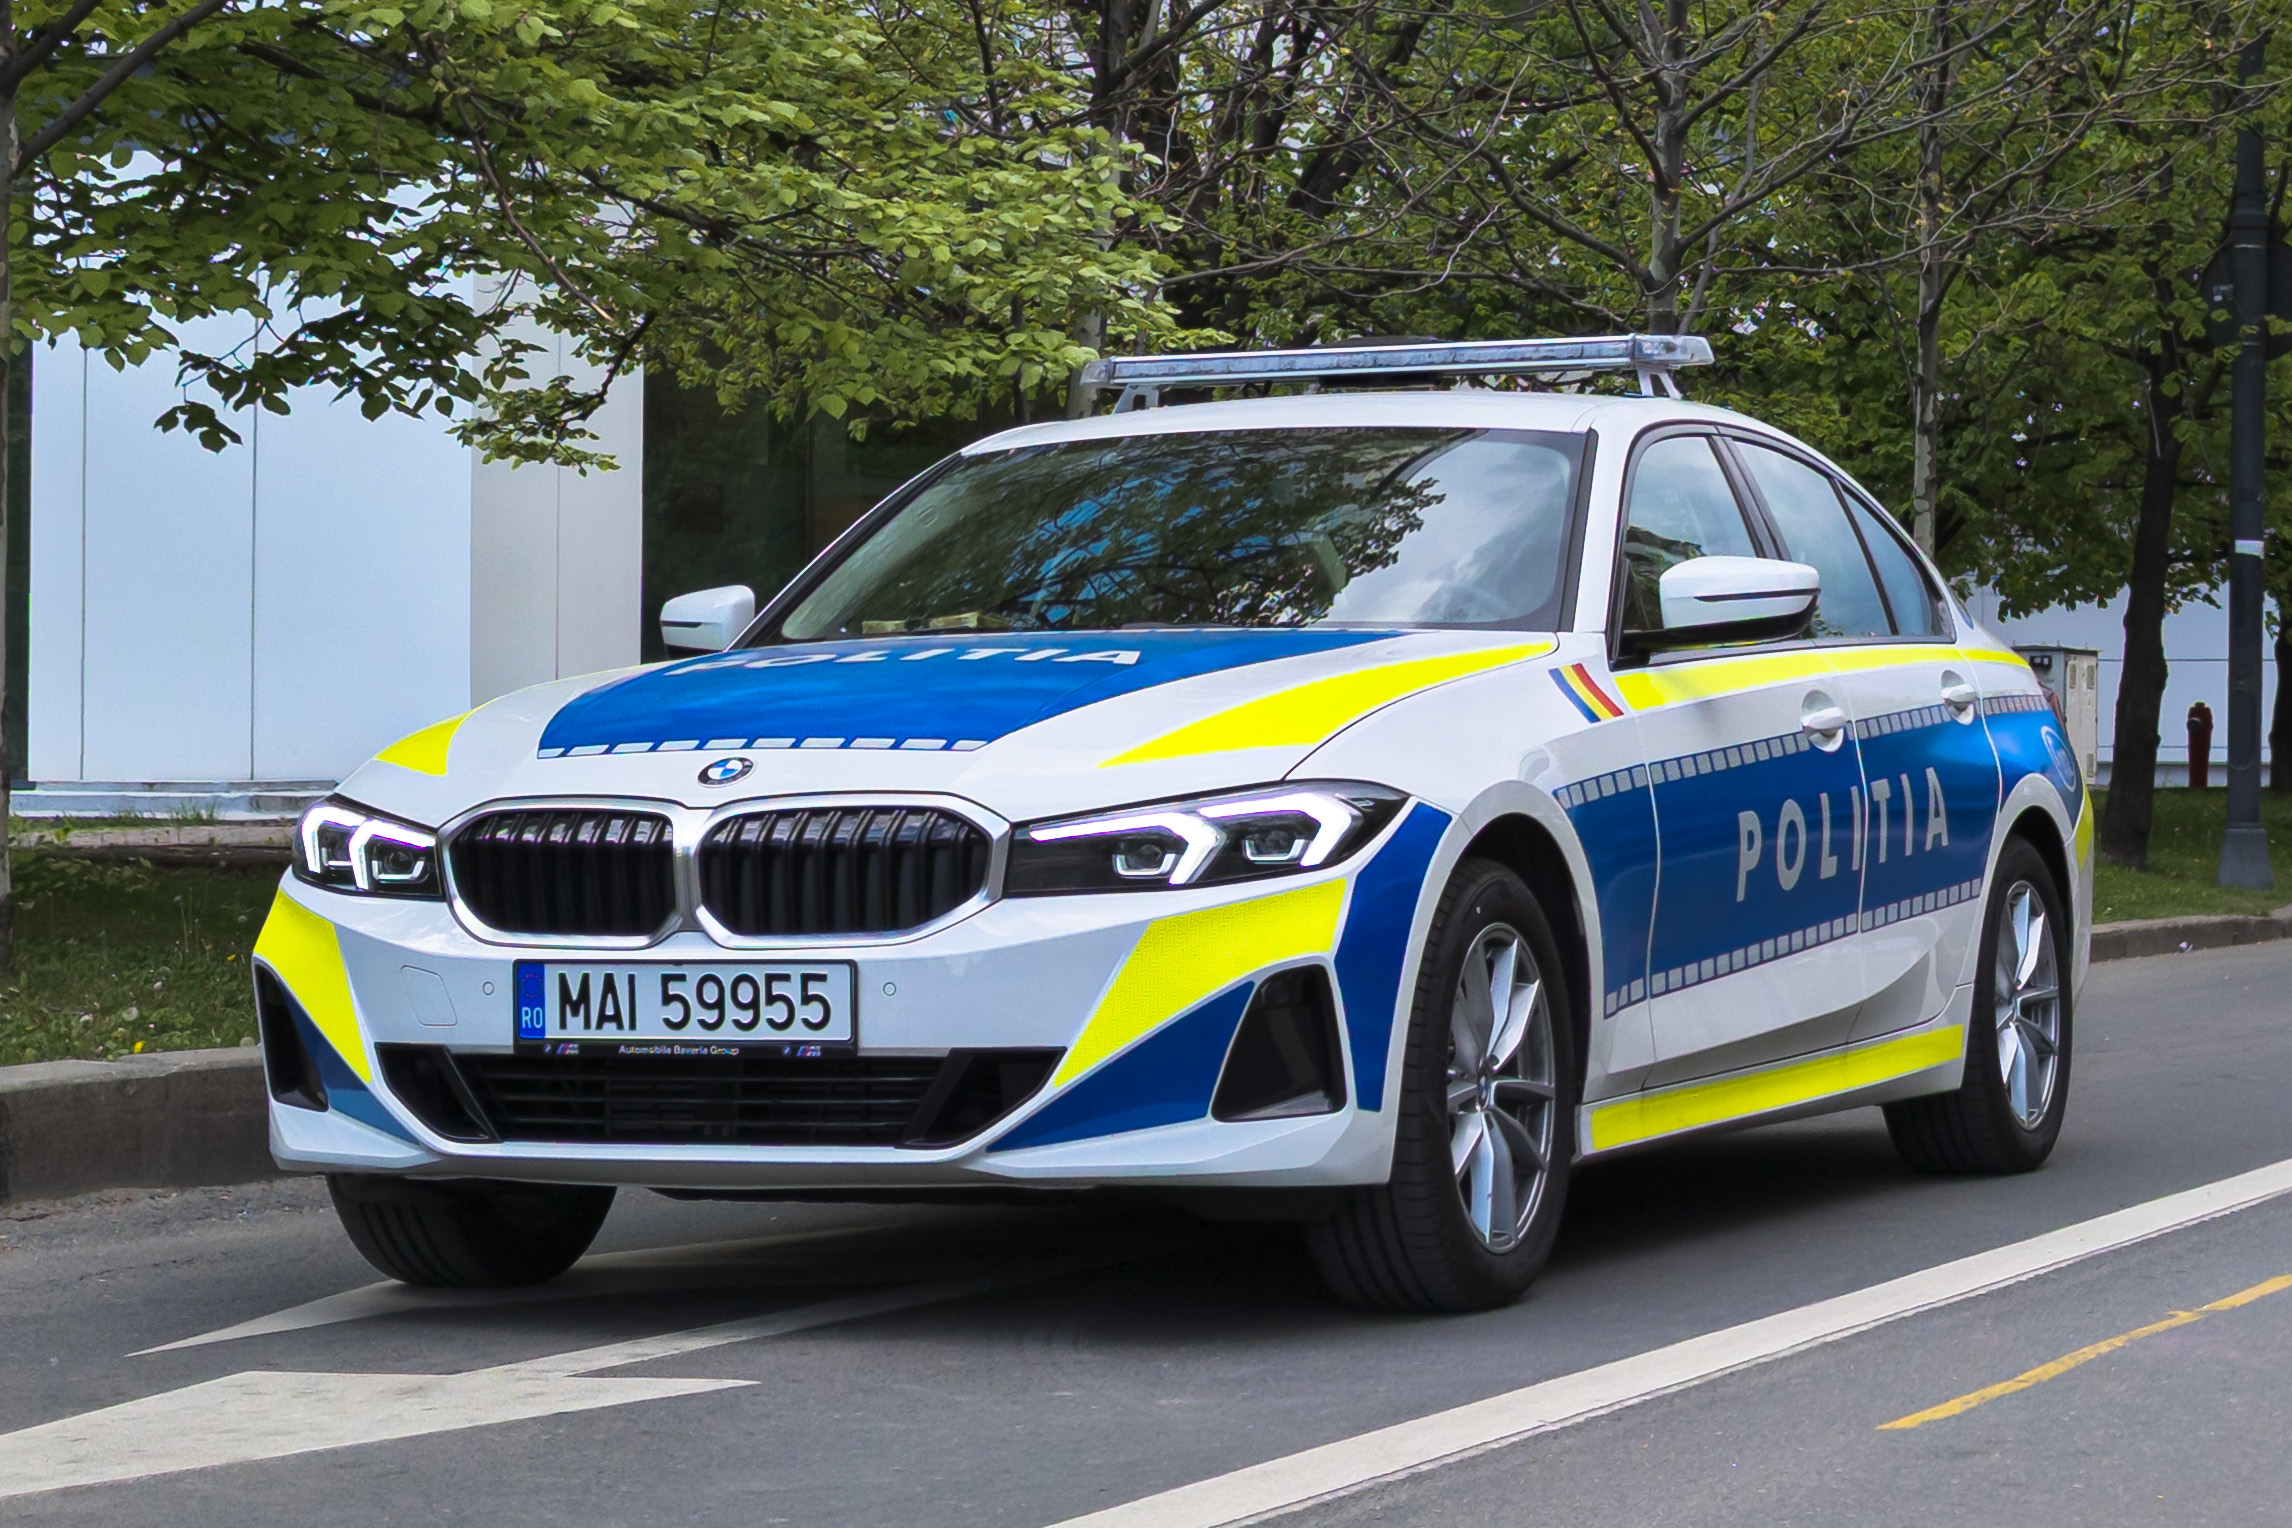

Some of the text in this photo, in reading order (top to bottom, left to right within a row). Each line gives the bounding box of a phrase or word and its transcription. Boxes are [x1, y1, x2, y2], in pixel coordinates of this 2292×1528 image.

[1737, 767, 1948, 902] POLITIA
[522, 1007, 543, 1029] RO
[558, 972, 832, 1032] MAI 59955
[619, 1044, 672, 1055] Automobile
